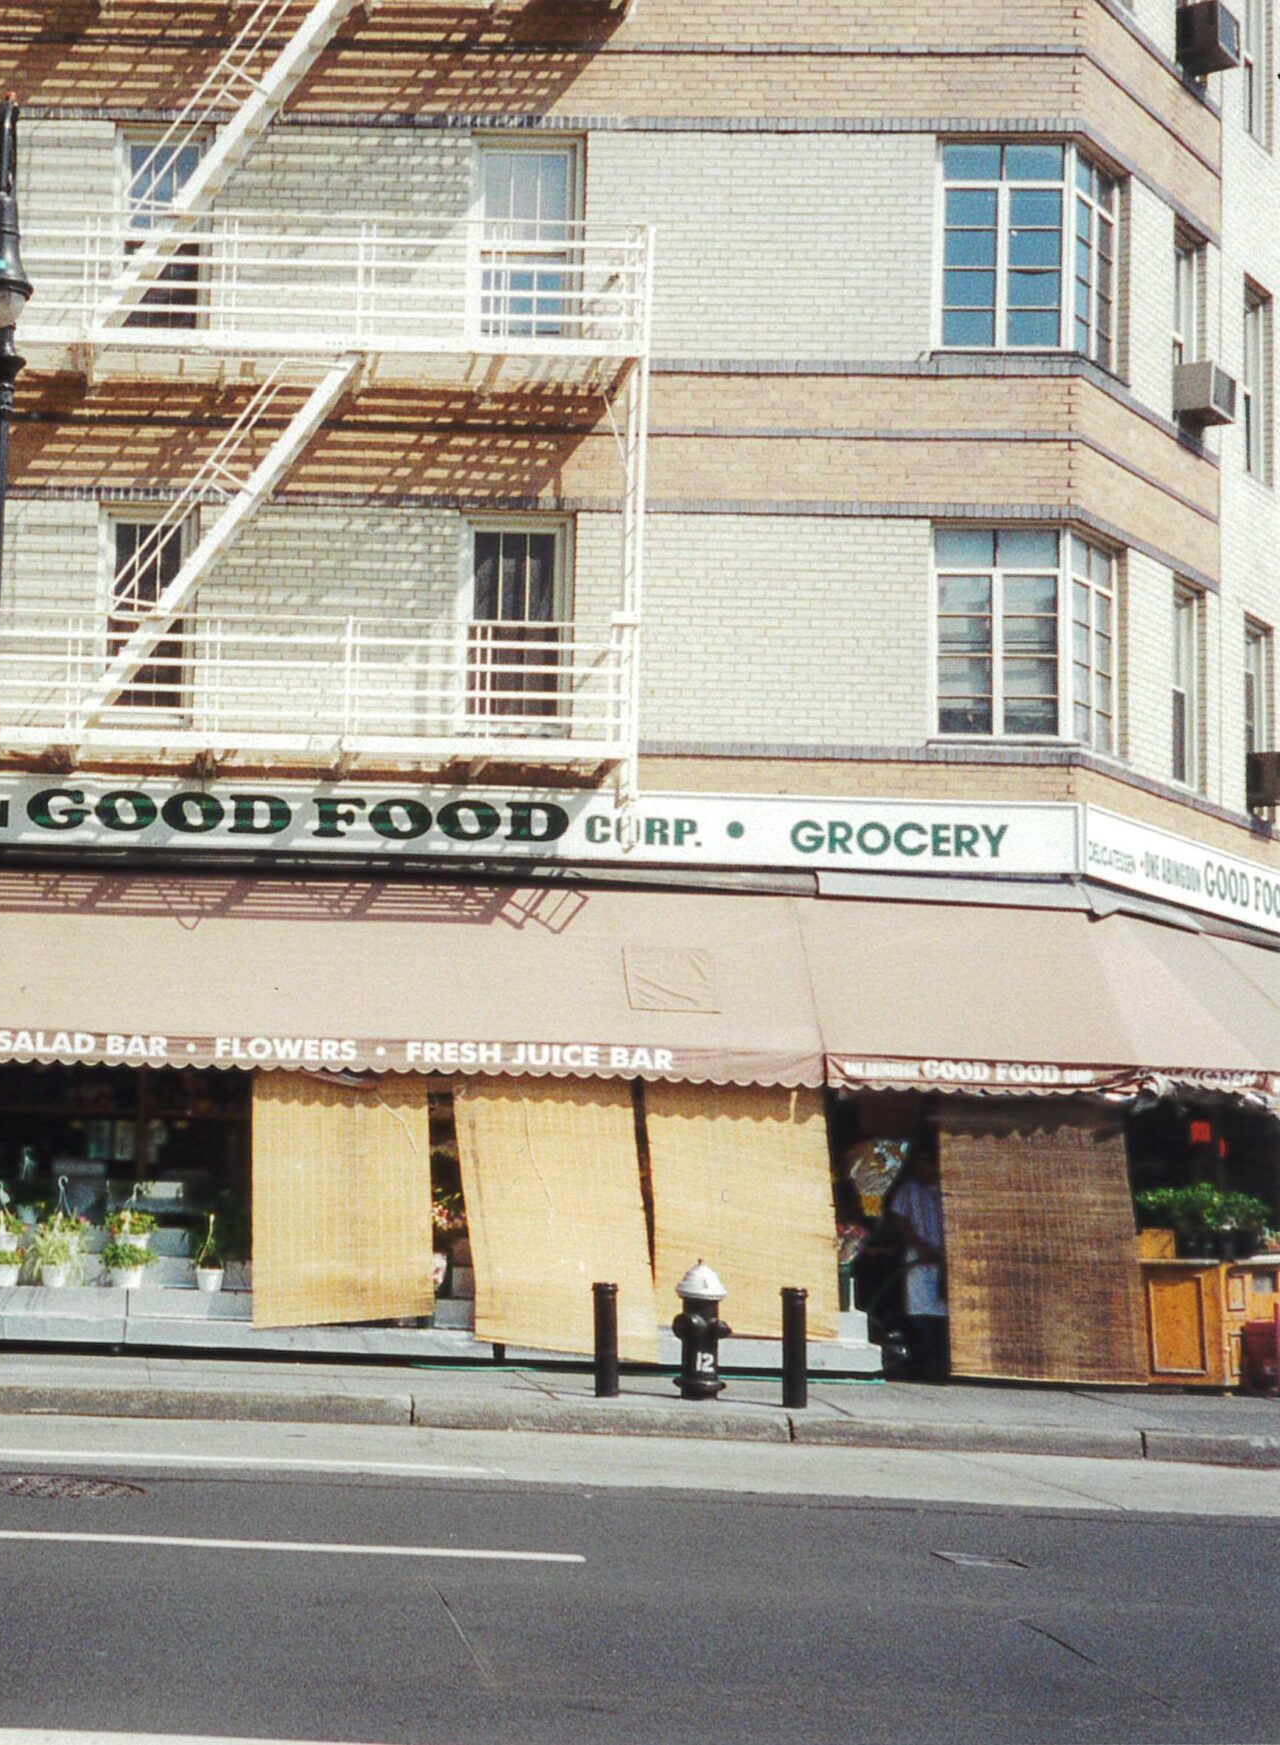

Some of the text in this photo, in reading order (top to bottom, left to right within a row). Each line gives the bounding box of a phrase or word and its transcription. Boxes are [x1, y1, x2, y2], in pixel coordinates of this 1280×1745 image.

[26, 788, 292, 834] GOOD
[312, 797, 570, 842] FOOD
[790, 819, 1010, 858] GROCERY
[1203, 860, 1250, 908] GOOD
[104, 1035, 168, 1057] BAR
[214, 1037, 358, 1062] FLOWERS
[406, 1041, 501, 1064] FRESH
[510, 1043, 600, 1067] JUICE
[609, 1047, 673, 1071] BAR
[922, 1059, 990, 1081] GOOD
[995, 1062, 1061, 1084] FOOD
[696, 1351, 714, 1372] 12
